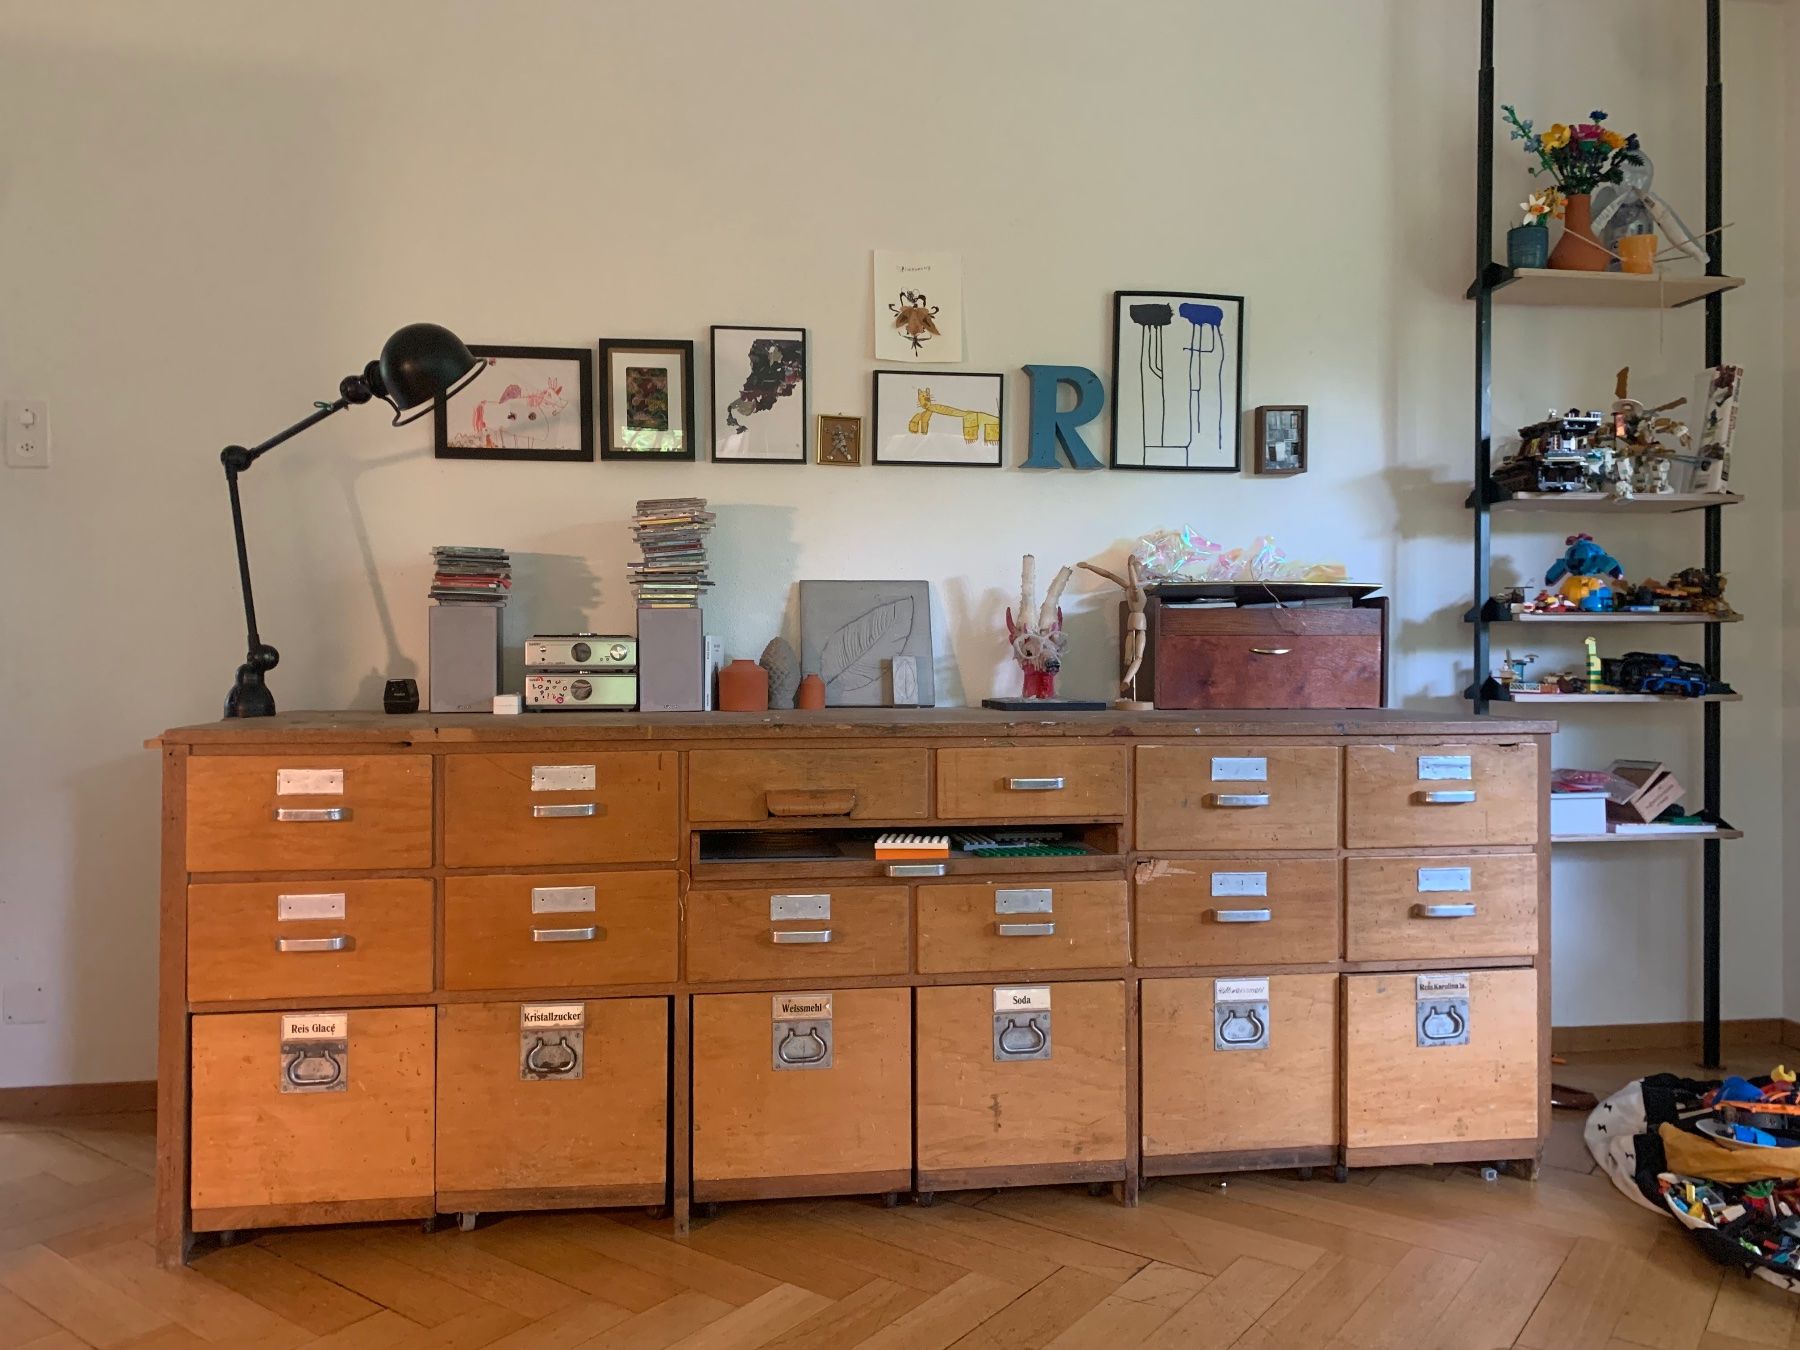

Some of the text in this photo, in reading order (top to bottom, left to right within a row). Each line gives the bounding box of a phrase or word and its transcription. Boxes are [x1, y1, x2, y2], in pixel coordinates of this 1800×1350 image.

[1019, 364, 1105, 470] R
[1012, 995, 1031, 1005] Soda
[782, 1003, 822, 1013] Weissmehl
[524, 1011, 581, 1022] Kristallzucker
[291, 1024, 310, 1034] Reis
